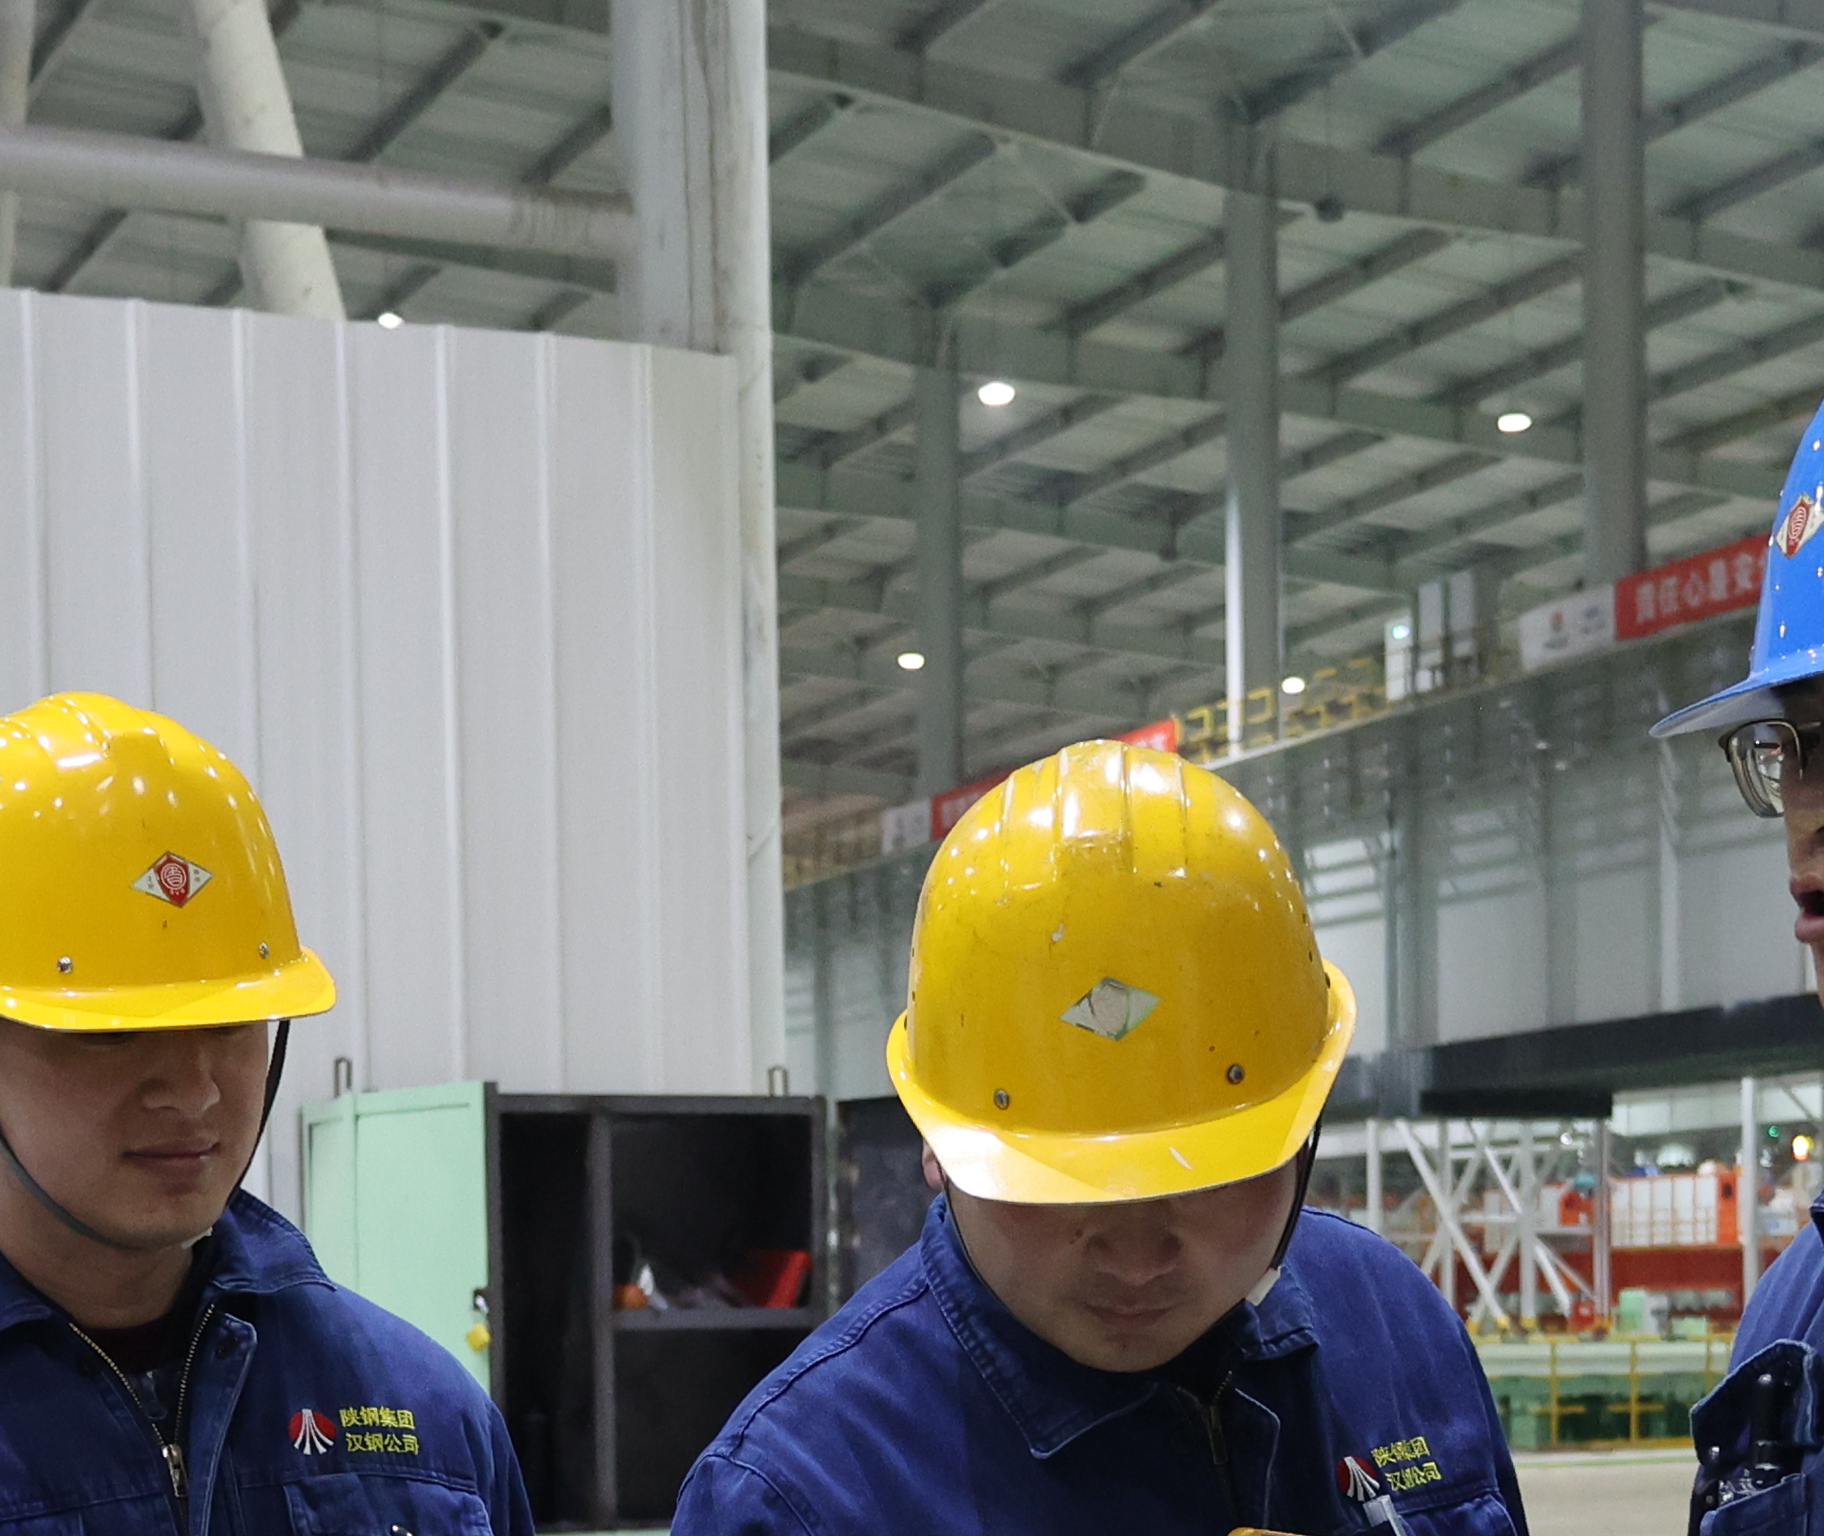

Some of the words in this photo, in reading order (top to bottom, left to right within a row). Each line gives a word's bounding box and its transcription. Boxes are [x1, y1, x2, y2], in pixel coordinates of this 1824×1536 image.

[339, 1406, 416, 1430] 陕钢集团
[345, 1432, 419, 1455] 汉钢公司
